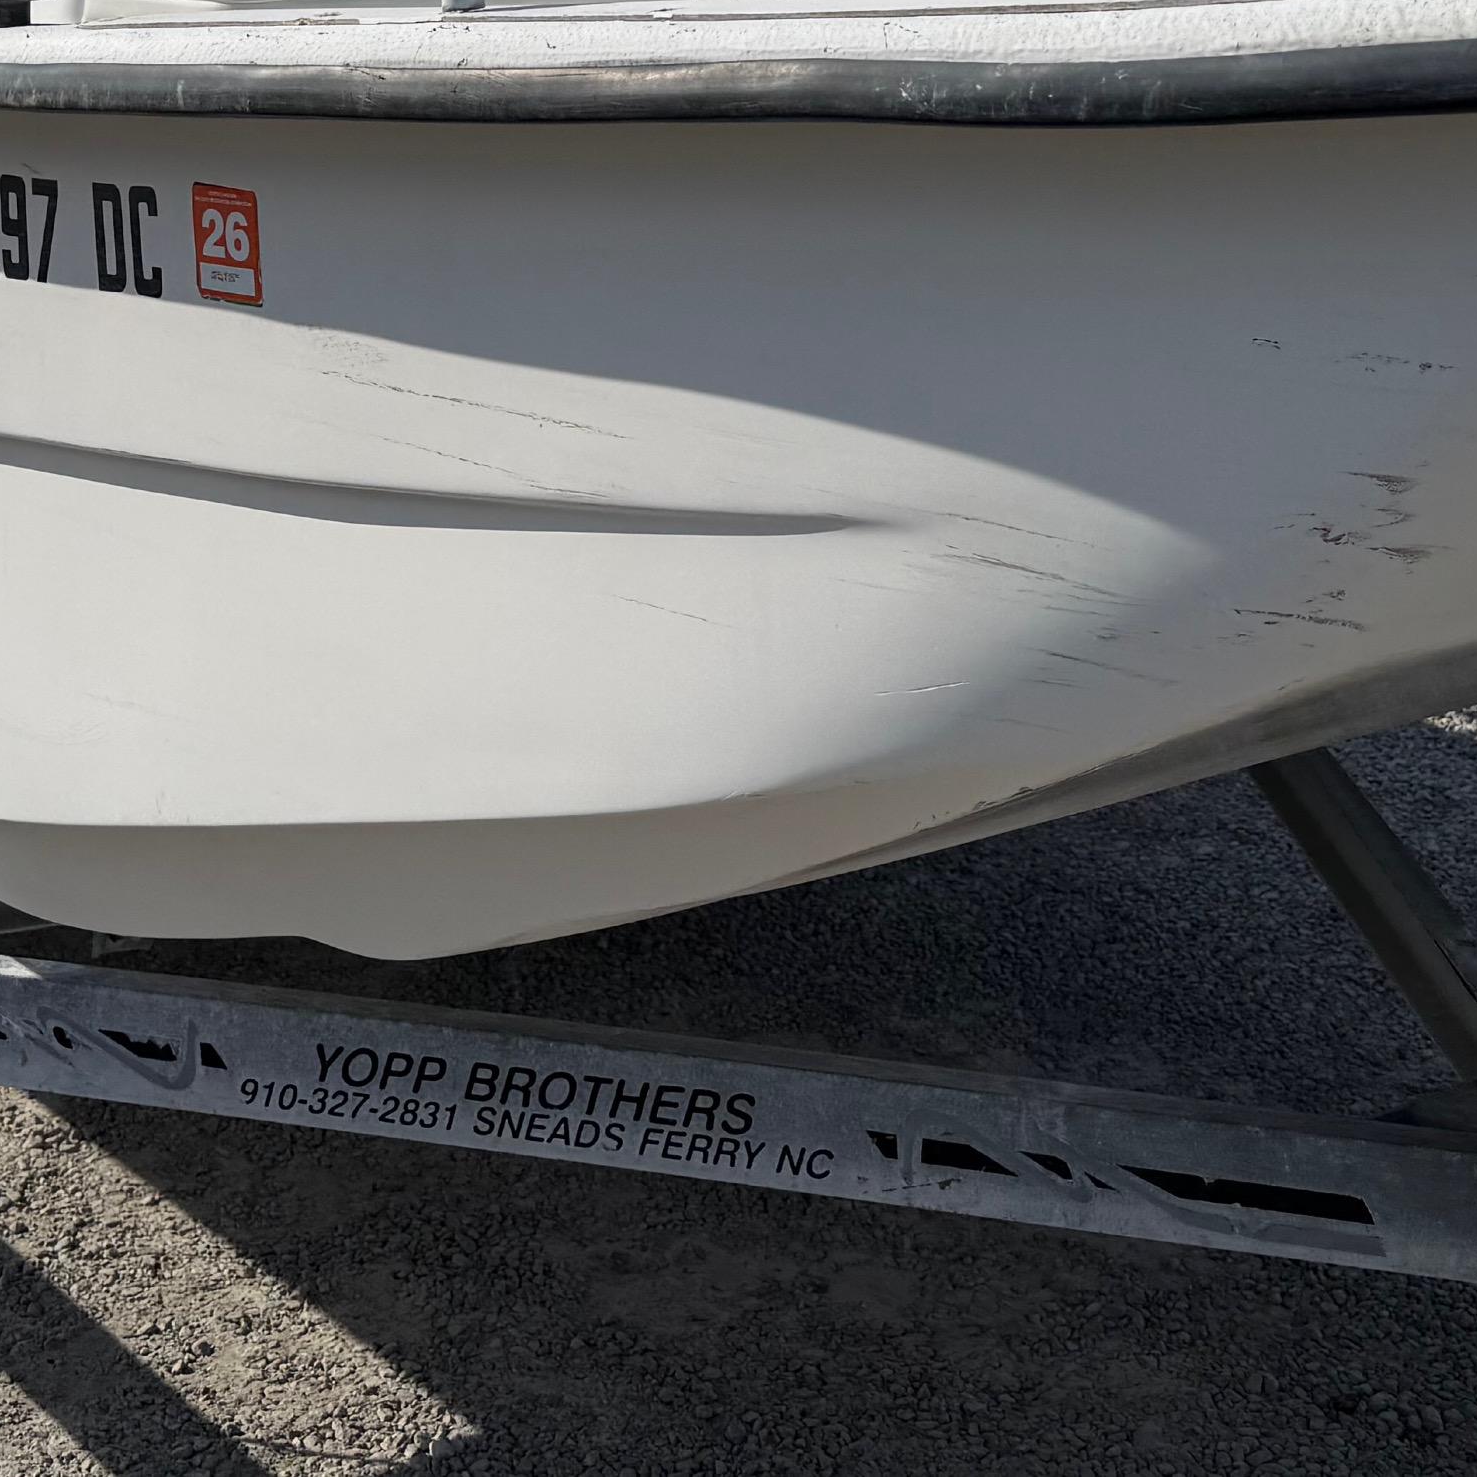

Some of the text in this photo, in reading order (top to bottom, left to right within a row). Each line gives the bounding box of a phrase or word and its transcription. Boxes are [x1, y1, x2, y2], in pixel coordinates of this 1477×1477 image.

[91, 181, 163, 299] DC
[201, 207, 251, 262] 26
[239, 1077, 835, 1180] 910-327-2831 SNEADS FERRY NC
[315, 1042, 757, 1136] YOPP BROTHERS
